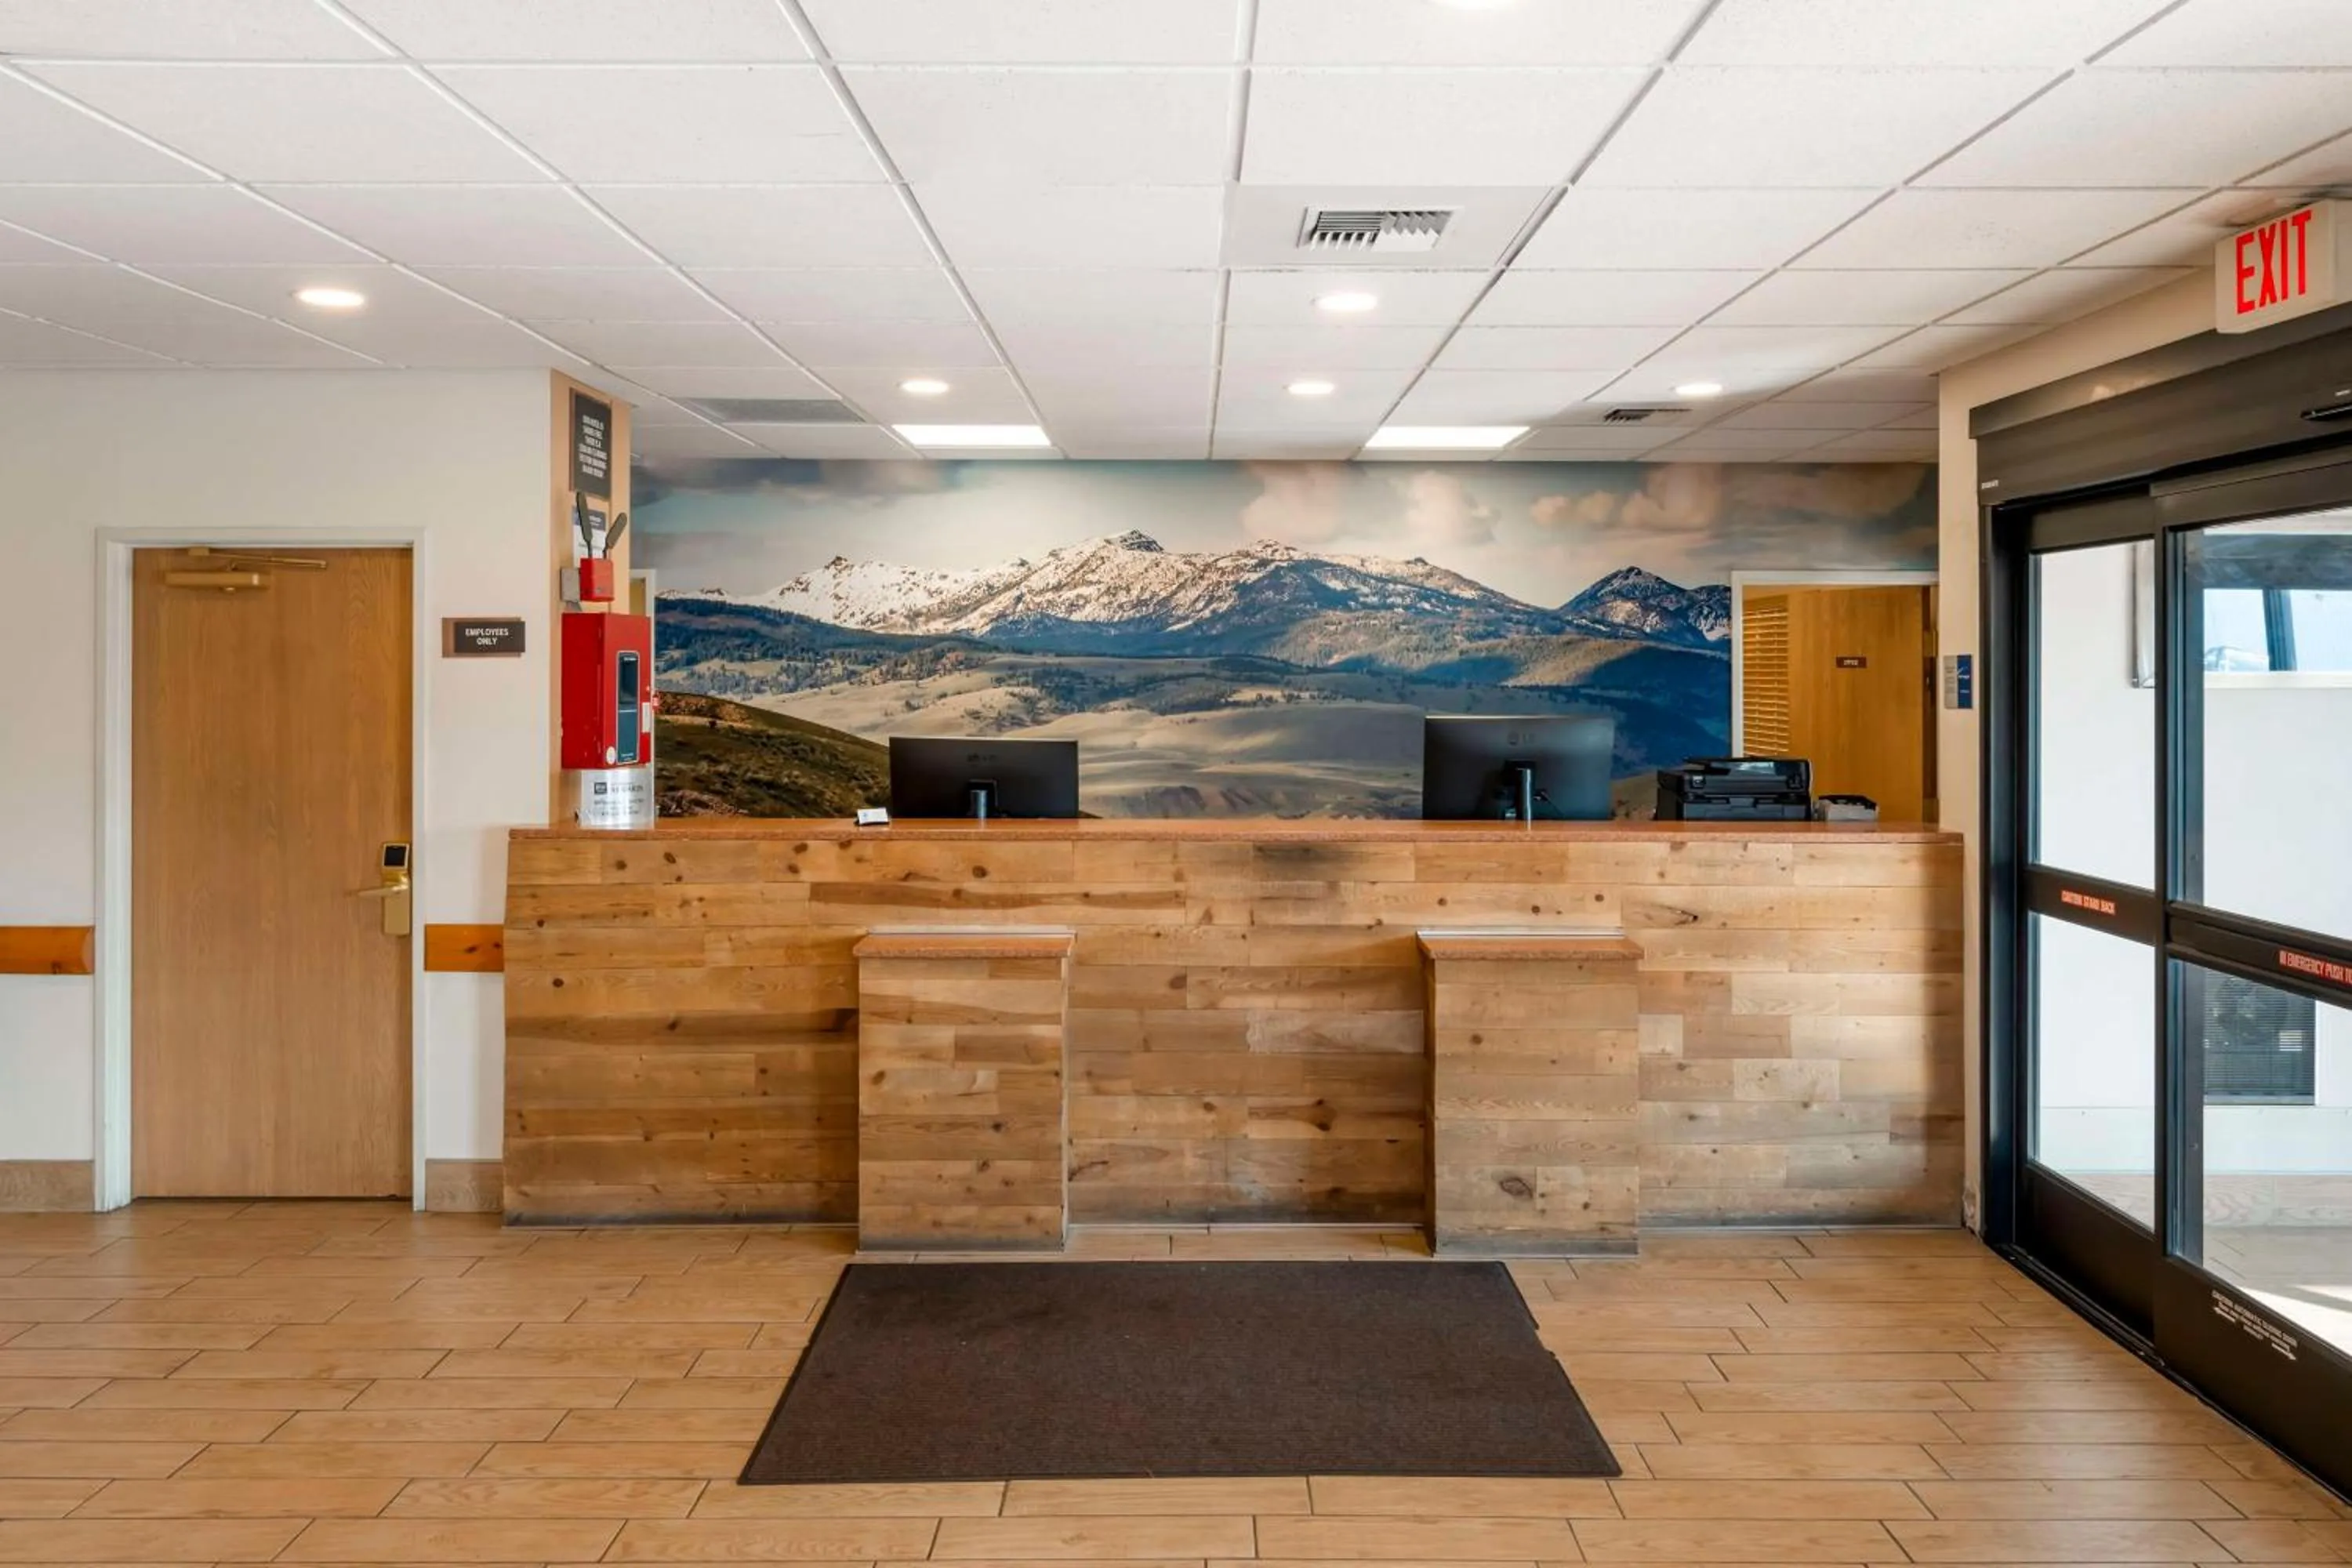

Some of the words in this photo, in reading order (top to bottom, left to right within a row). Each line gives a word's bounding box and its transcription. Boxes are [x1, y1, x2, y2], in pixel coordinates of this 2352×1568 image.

[2235, 209, 2312, 314] EXIT
[2287, 953, 2323, 975] EMERGENCY
[2325, 963, 2343, 980] PUSH
